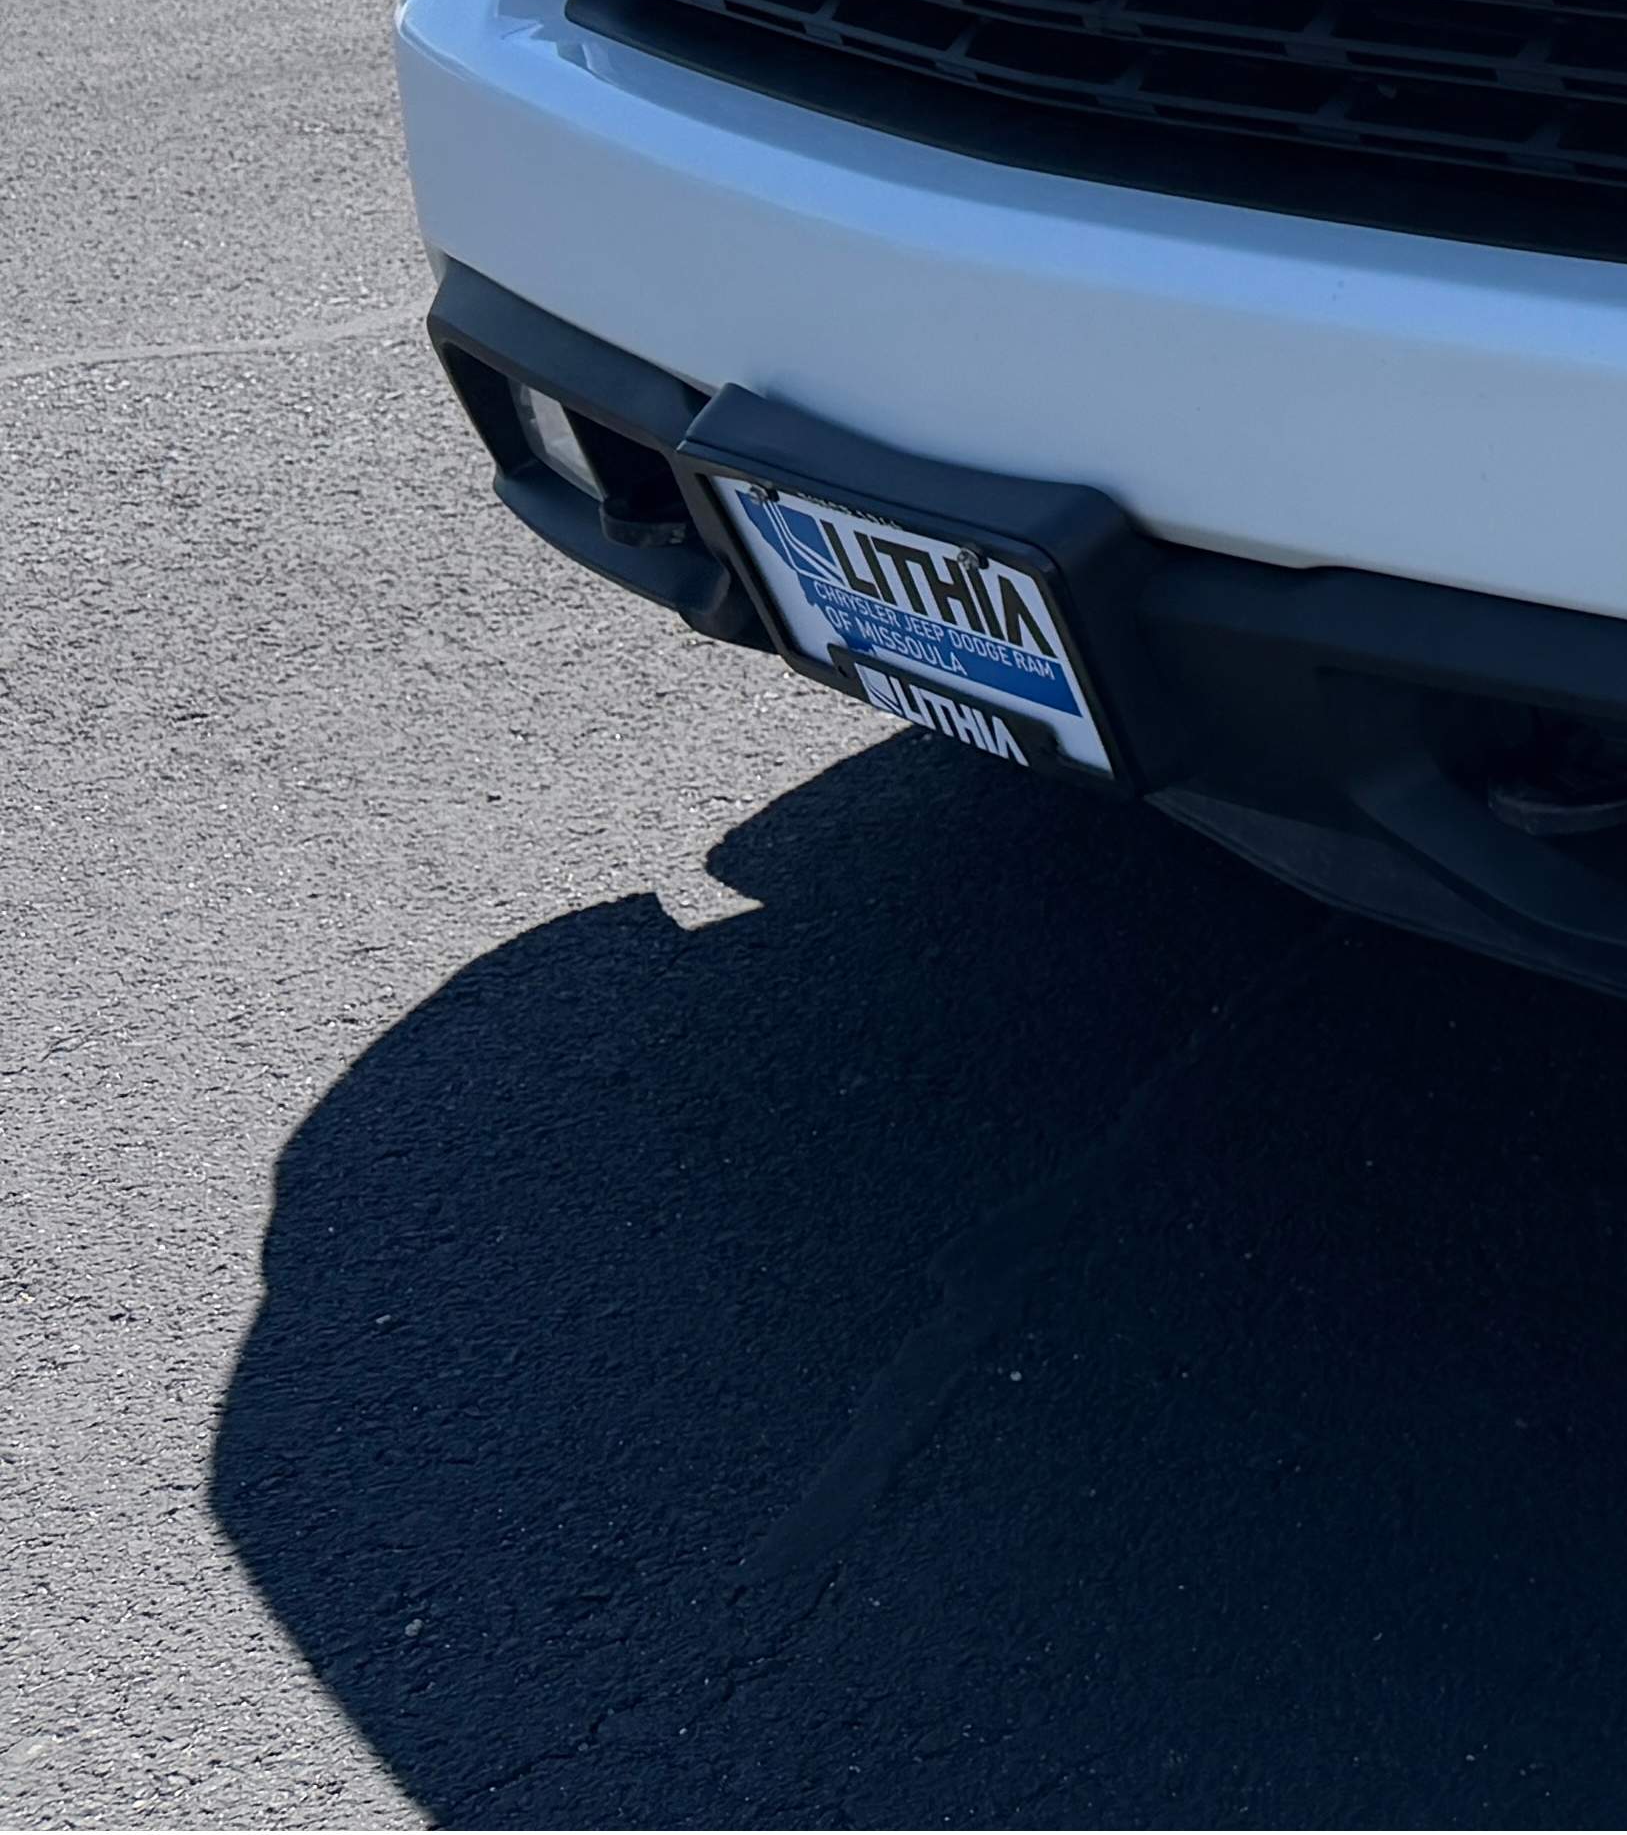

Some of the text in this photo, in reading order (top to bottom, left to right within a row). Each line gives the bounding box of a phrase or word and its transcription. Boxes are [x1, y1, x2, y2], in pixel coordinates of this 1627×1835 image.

[813, 581, 1056, 681] CHRYSLER JEEP DODGE RAM
[819, 519, 1058, 659] LITHIA
[825, 606, 968, 676] OF MISSOULA
[889, 675, 1029, 767] LITHIA
